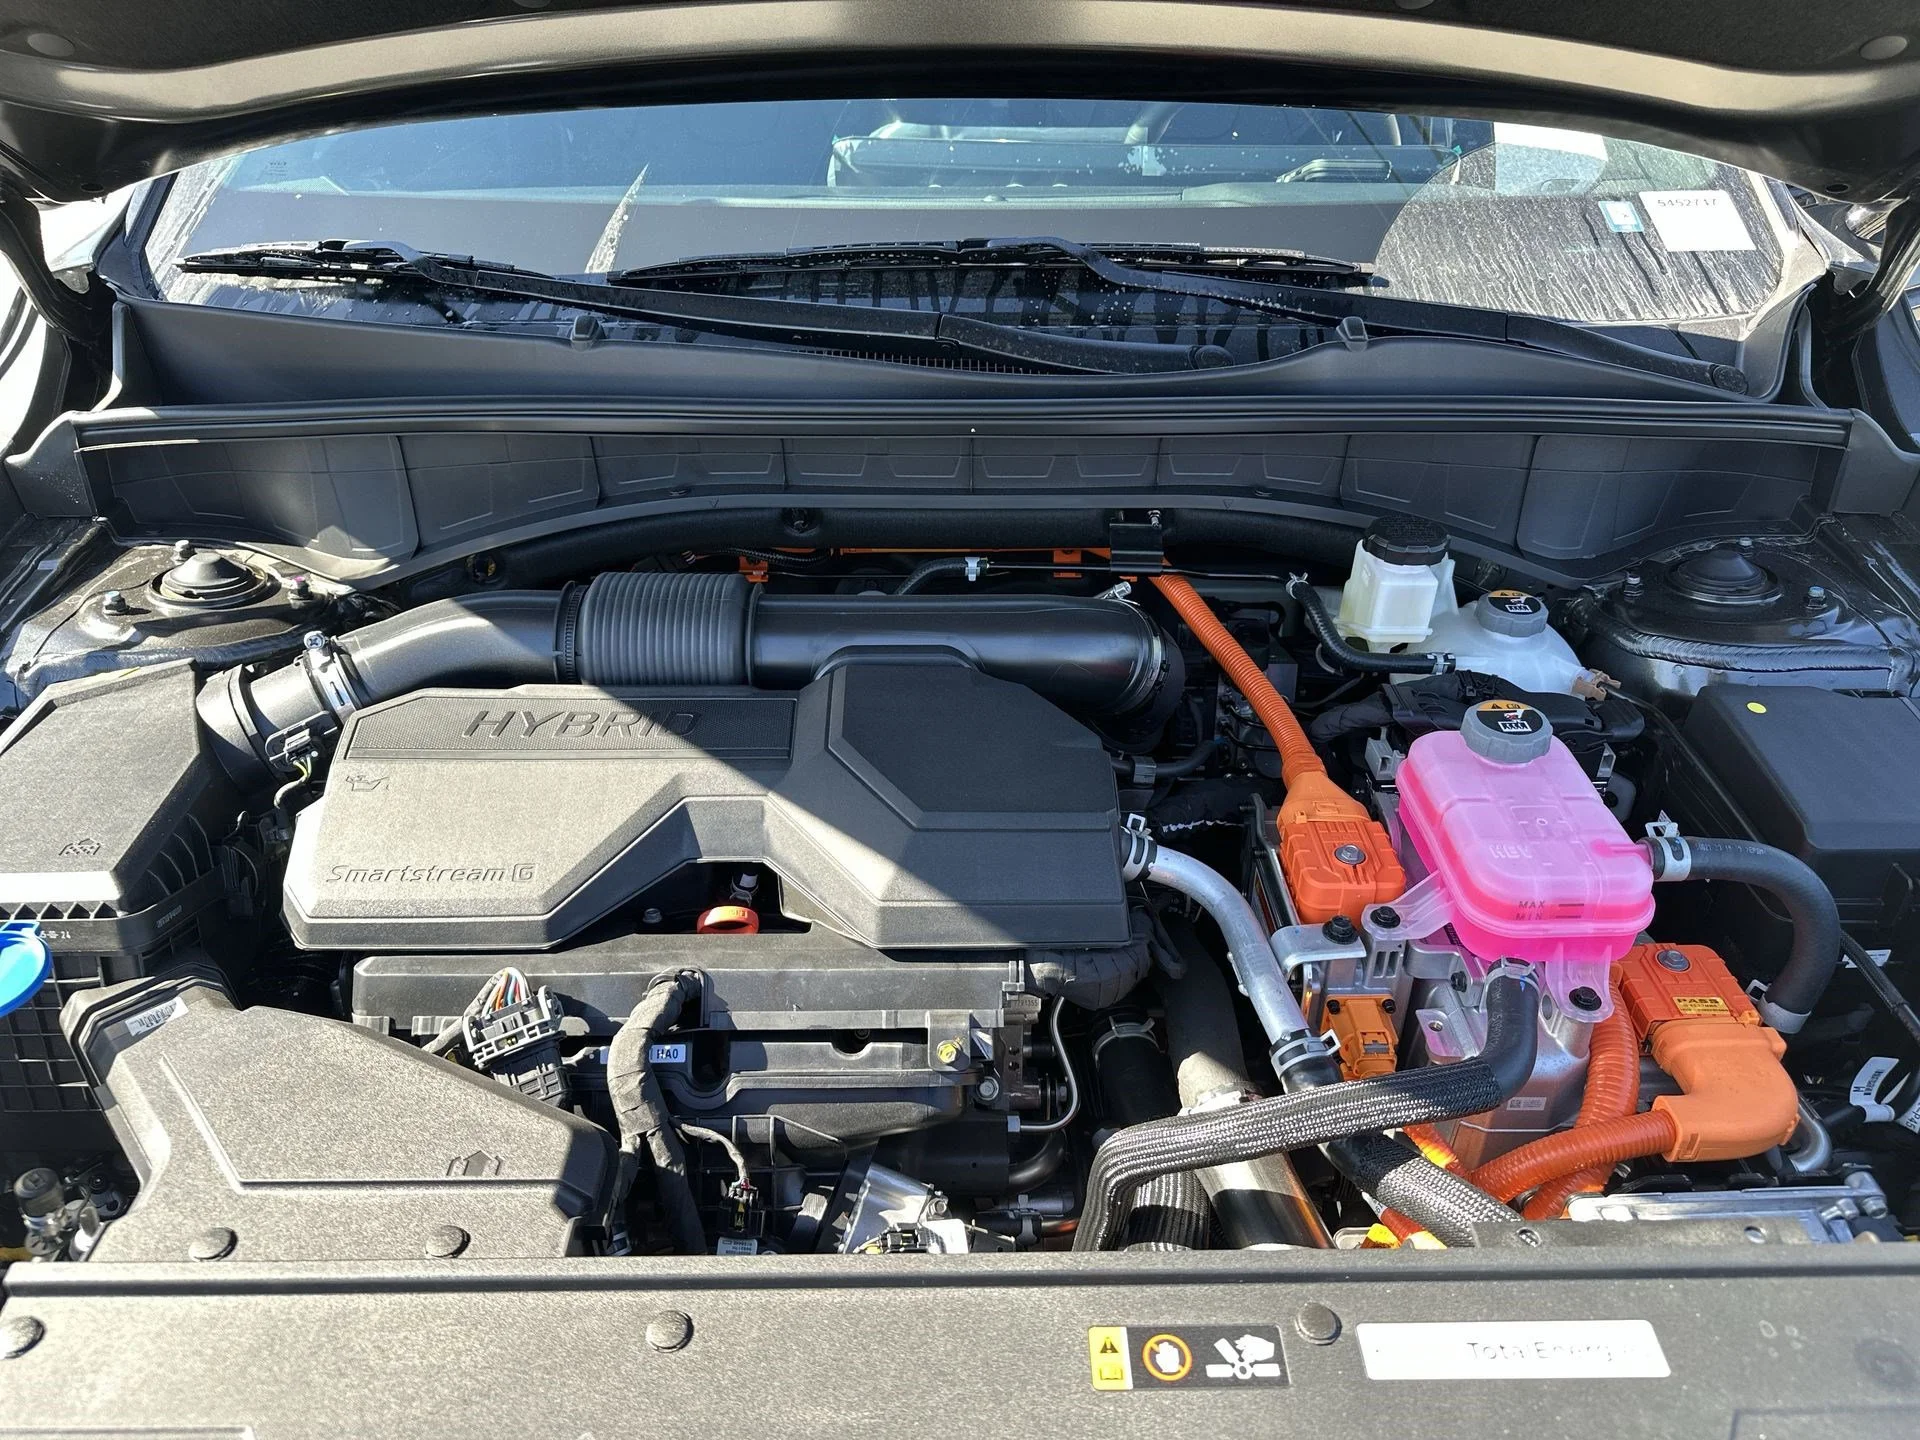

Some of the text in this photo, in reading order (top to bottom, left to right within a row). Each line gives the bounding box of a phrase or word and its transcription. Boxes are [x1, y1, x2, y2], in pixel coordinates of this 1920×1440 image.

[461, 709, 702, 738] HYBRID
[326, 863, 535, 883] Smartstream G
[1518, 900, 1546, 909] MAX
[1515, 912, 1543, 921] MIN
